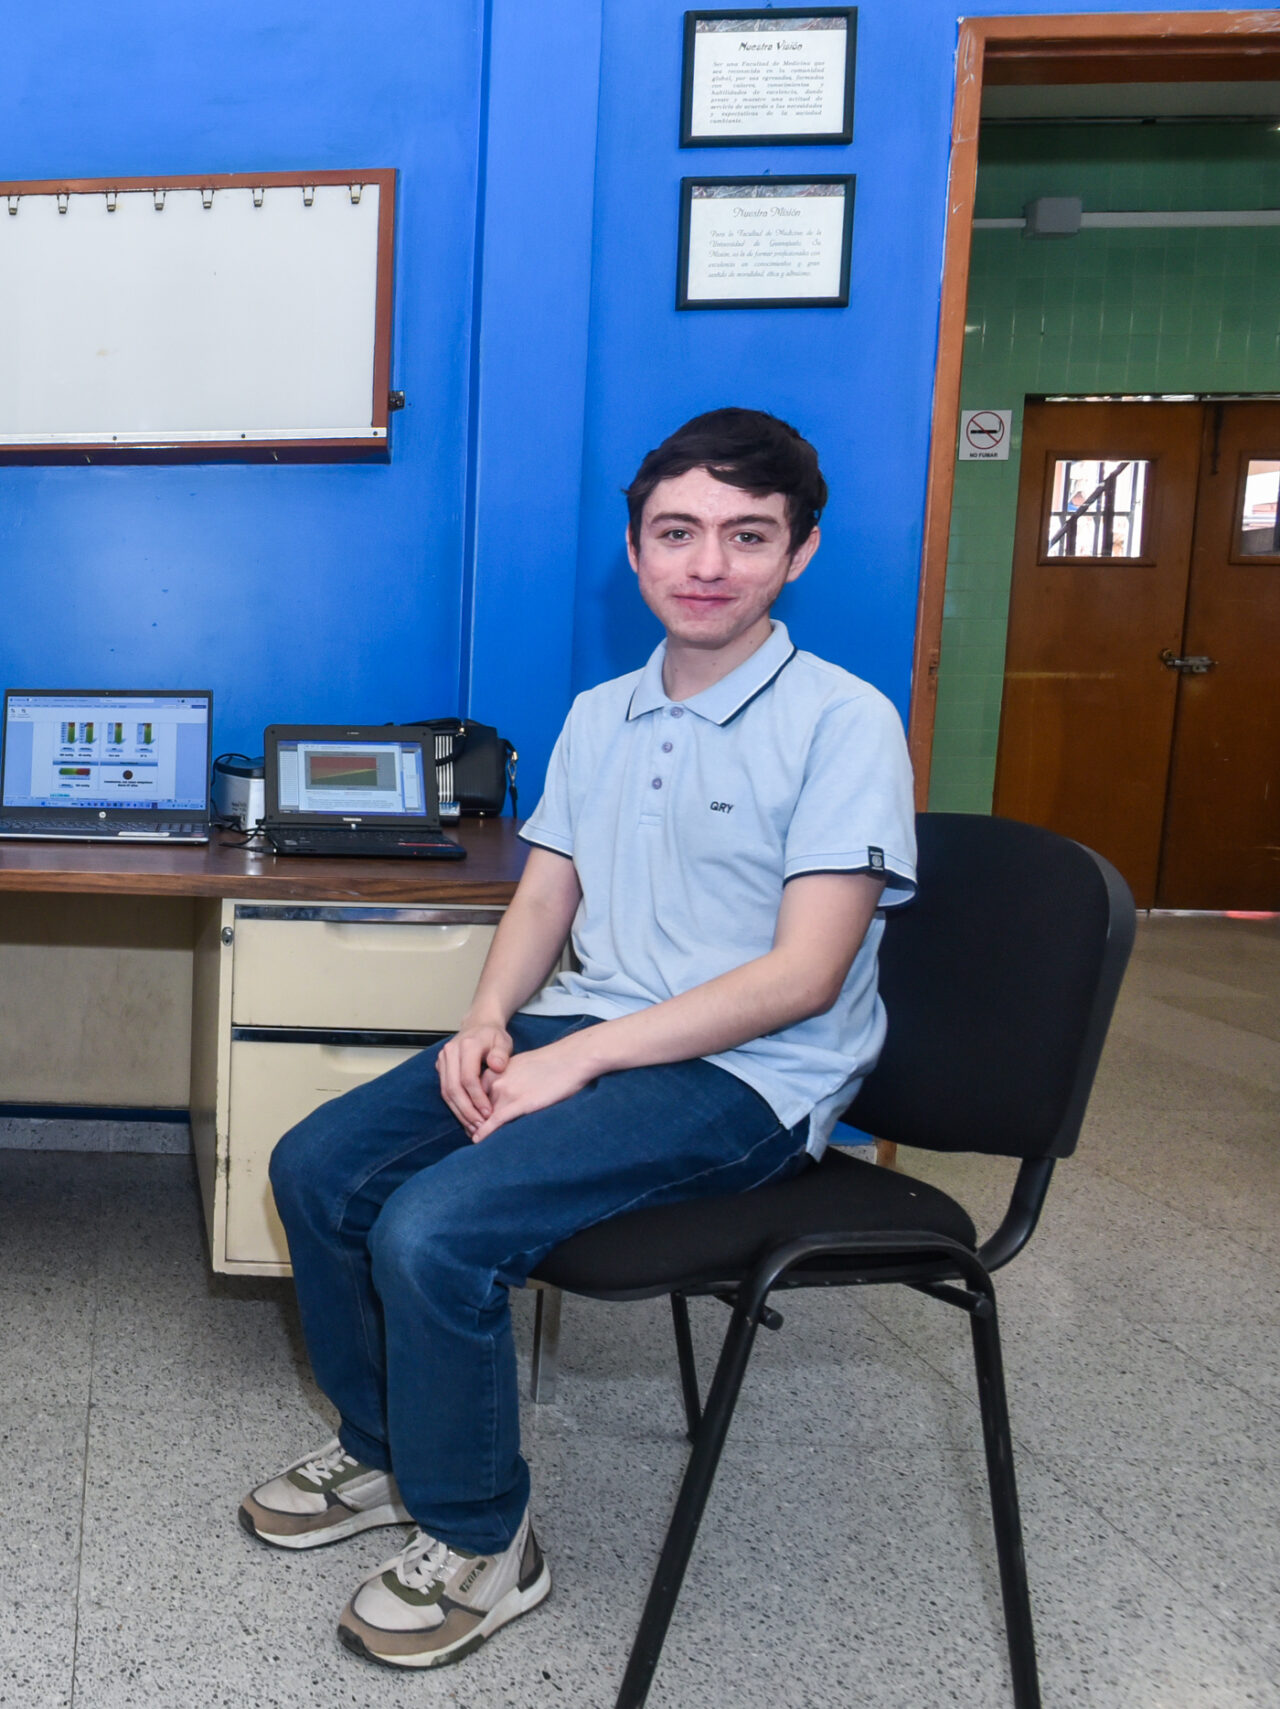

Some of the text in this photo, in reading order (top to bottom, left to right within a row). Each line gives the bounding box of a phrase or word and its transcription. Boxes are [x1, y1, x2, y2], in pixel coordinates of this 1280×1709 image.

[738, 40, 803, 51] Nuestra Visión
[733, 207, 801, 217] Nuestra Misión
[710, 801, 734, 814] QRY
